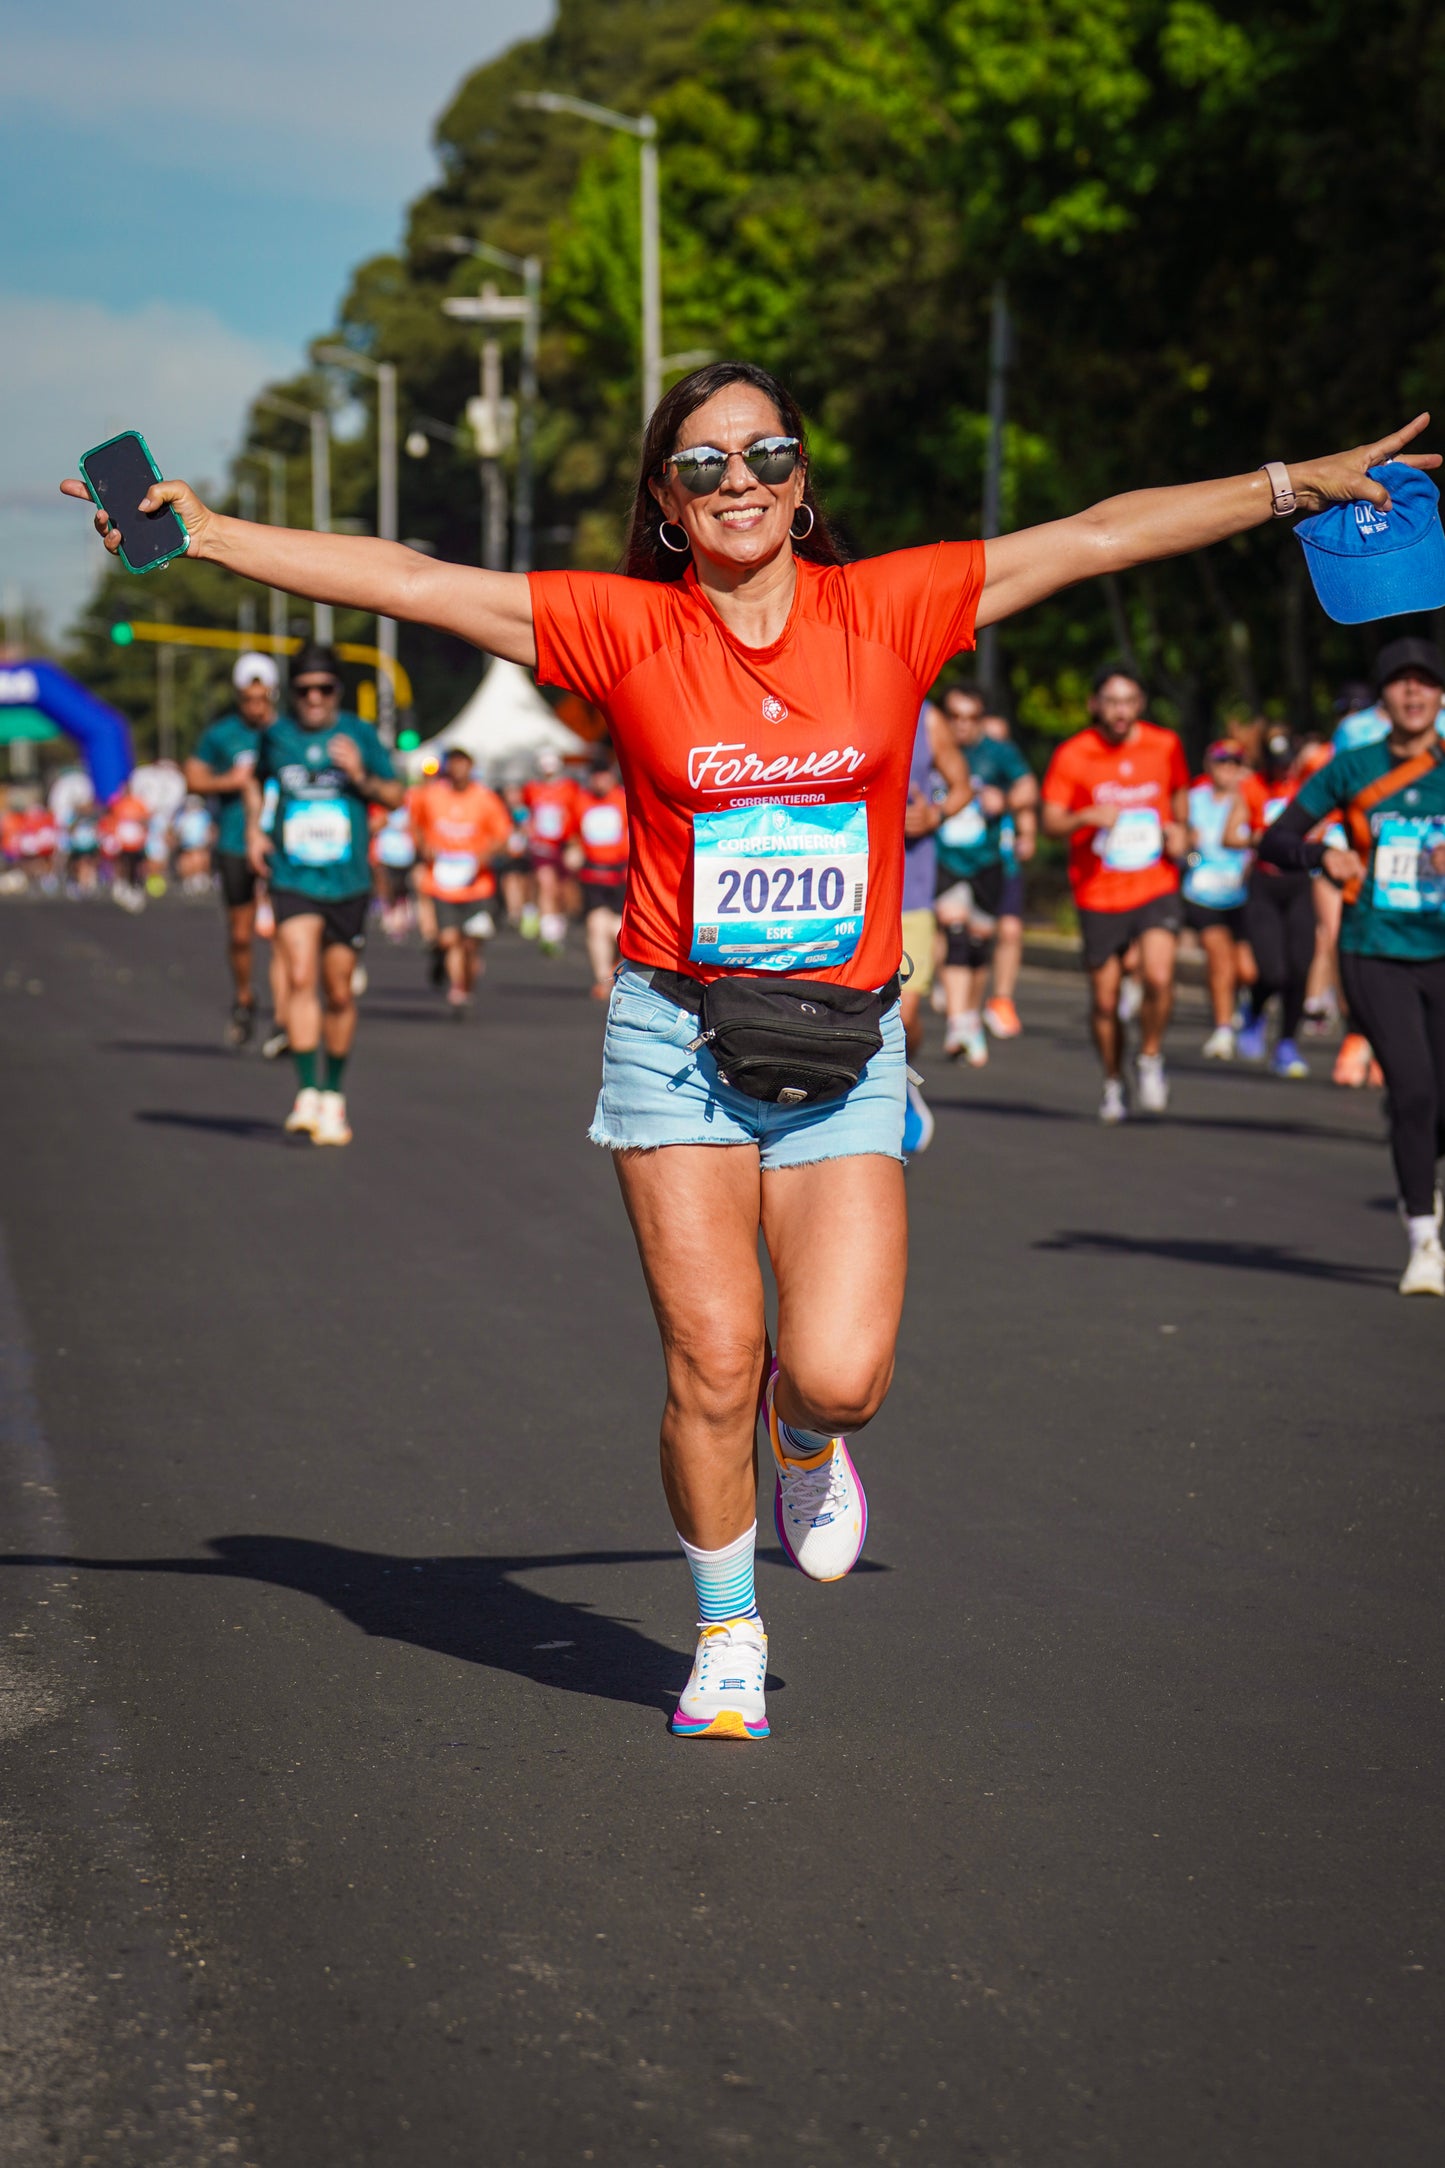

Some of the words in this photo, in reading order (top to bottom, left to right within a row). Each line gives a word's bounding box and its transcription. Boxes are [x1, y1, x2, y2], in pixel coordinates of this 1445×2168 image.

[687, 741, 867, 790] Forever
[716, 866, 845, 914] 20210
[766, 926, 794, 940] ESPE
[834, 921, 855, 935] 10K
